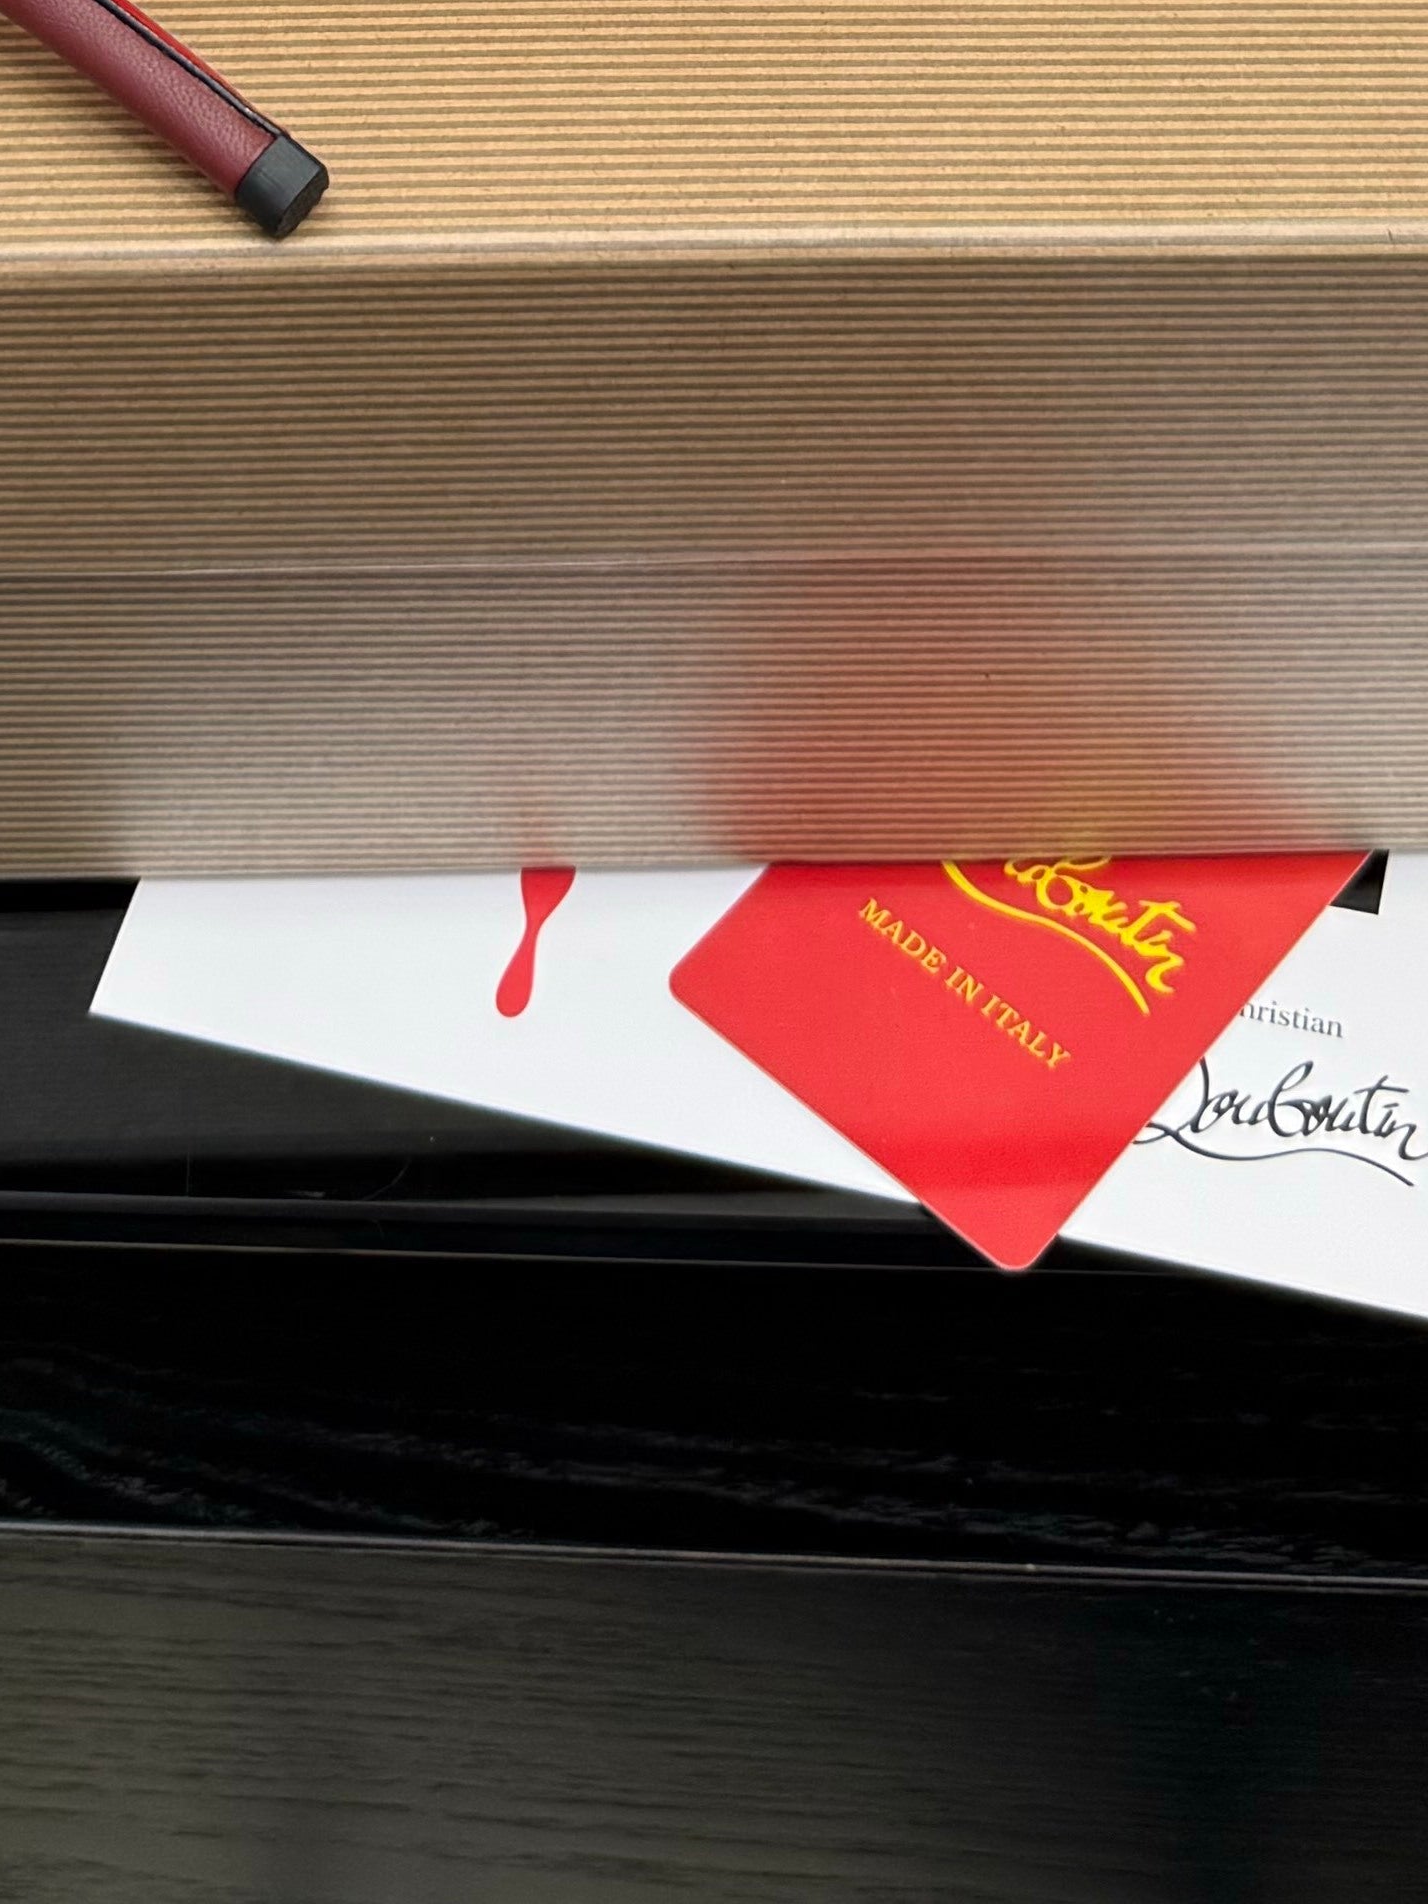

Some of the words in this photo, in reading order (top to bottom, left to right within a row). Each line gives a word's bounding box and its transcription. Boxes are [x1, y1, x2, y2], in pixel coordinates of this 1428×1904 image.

[859, 896, 947, 975] MADE
[944, 966, 985, 1004] IN
[981, 994, 1071, 1070] ITALY
[1239, 1000, 1344, 1038] hristian
